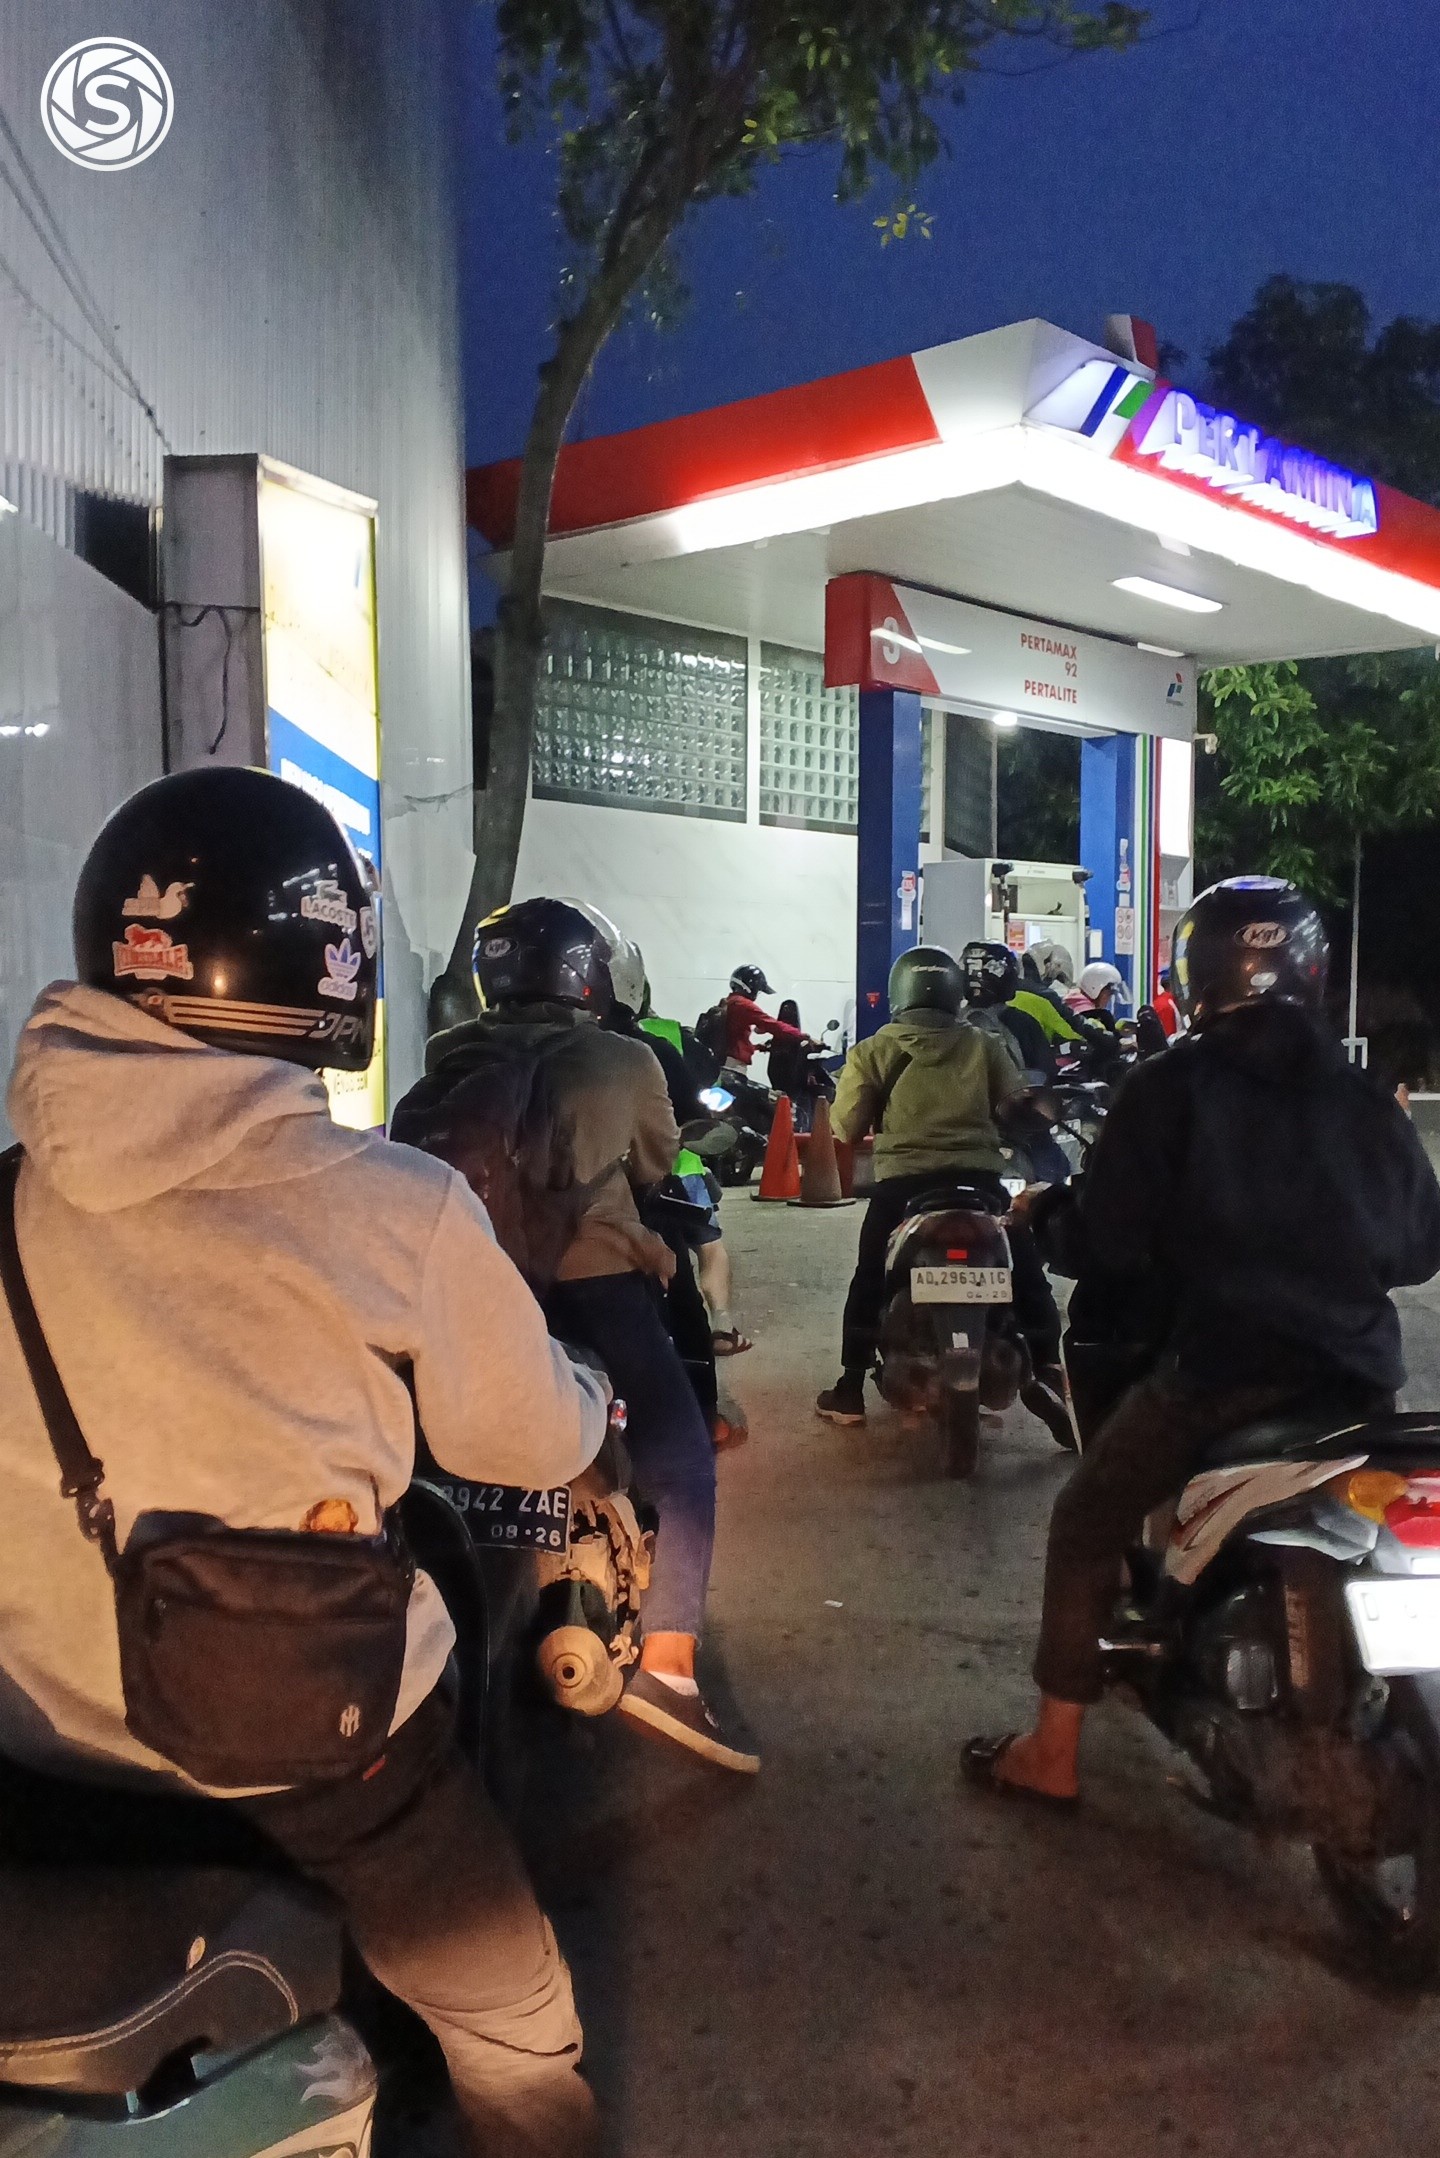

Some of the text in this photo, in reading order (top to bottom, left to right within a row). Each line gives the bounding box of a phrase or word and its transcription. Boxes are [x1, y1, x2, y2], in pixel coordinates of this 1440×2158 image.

[1020, 633, 1078, 660] PERTAMAX
[1065, 661, 1078, 678] 92
[1024, 679, 1078, 704] PERTALITE
